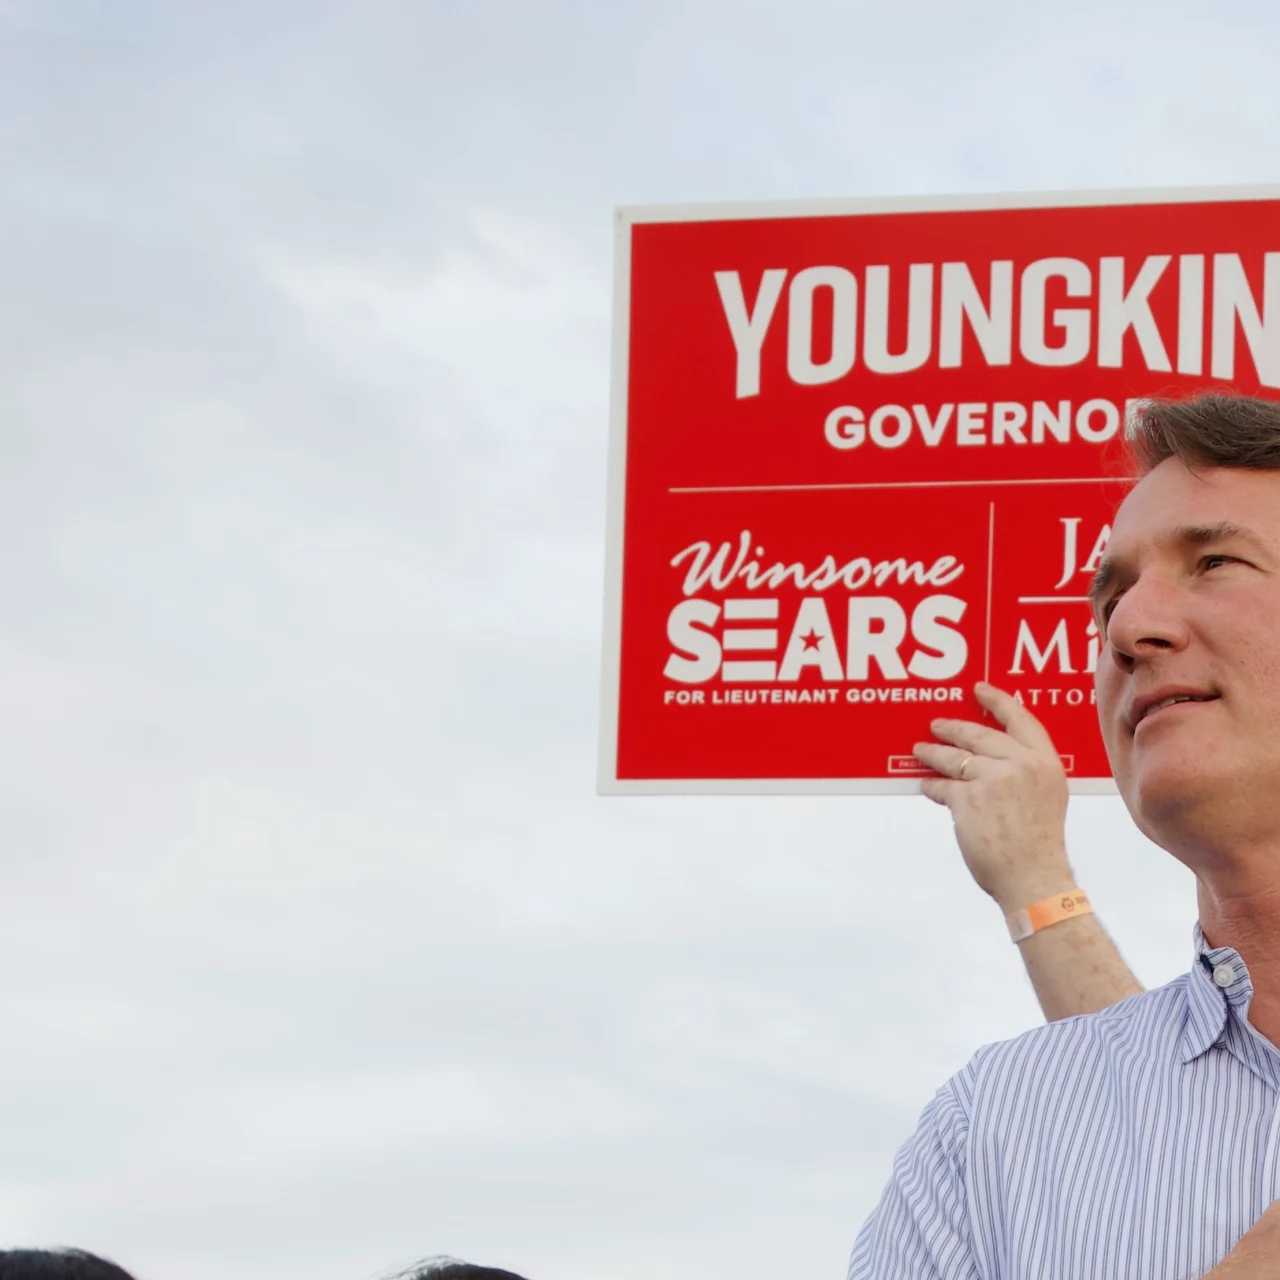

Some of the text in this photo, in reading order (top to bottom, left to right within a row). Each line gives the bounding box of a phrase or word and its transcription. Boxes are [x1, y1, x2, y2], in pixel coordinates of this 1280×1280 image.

[670, 530, 965, 597] Winsome
[663, 594, 968, 684] SEARS
[663, 686, 963, 705] FOR LIEUTENANT GOVERNOR
